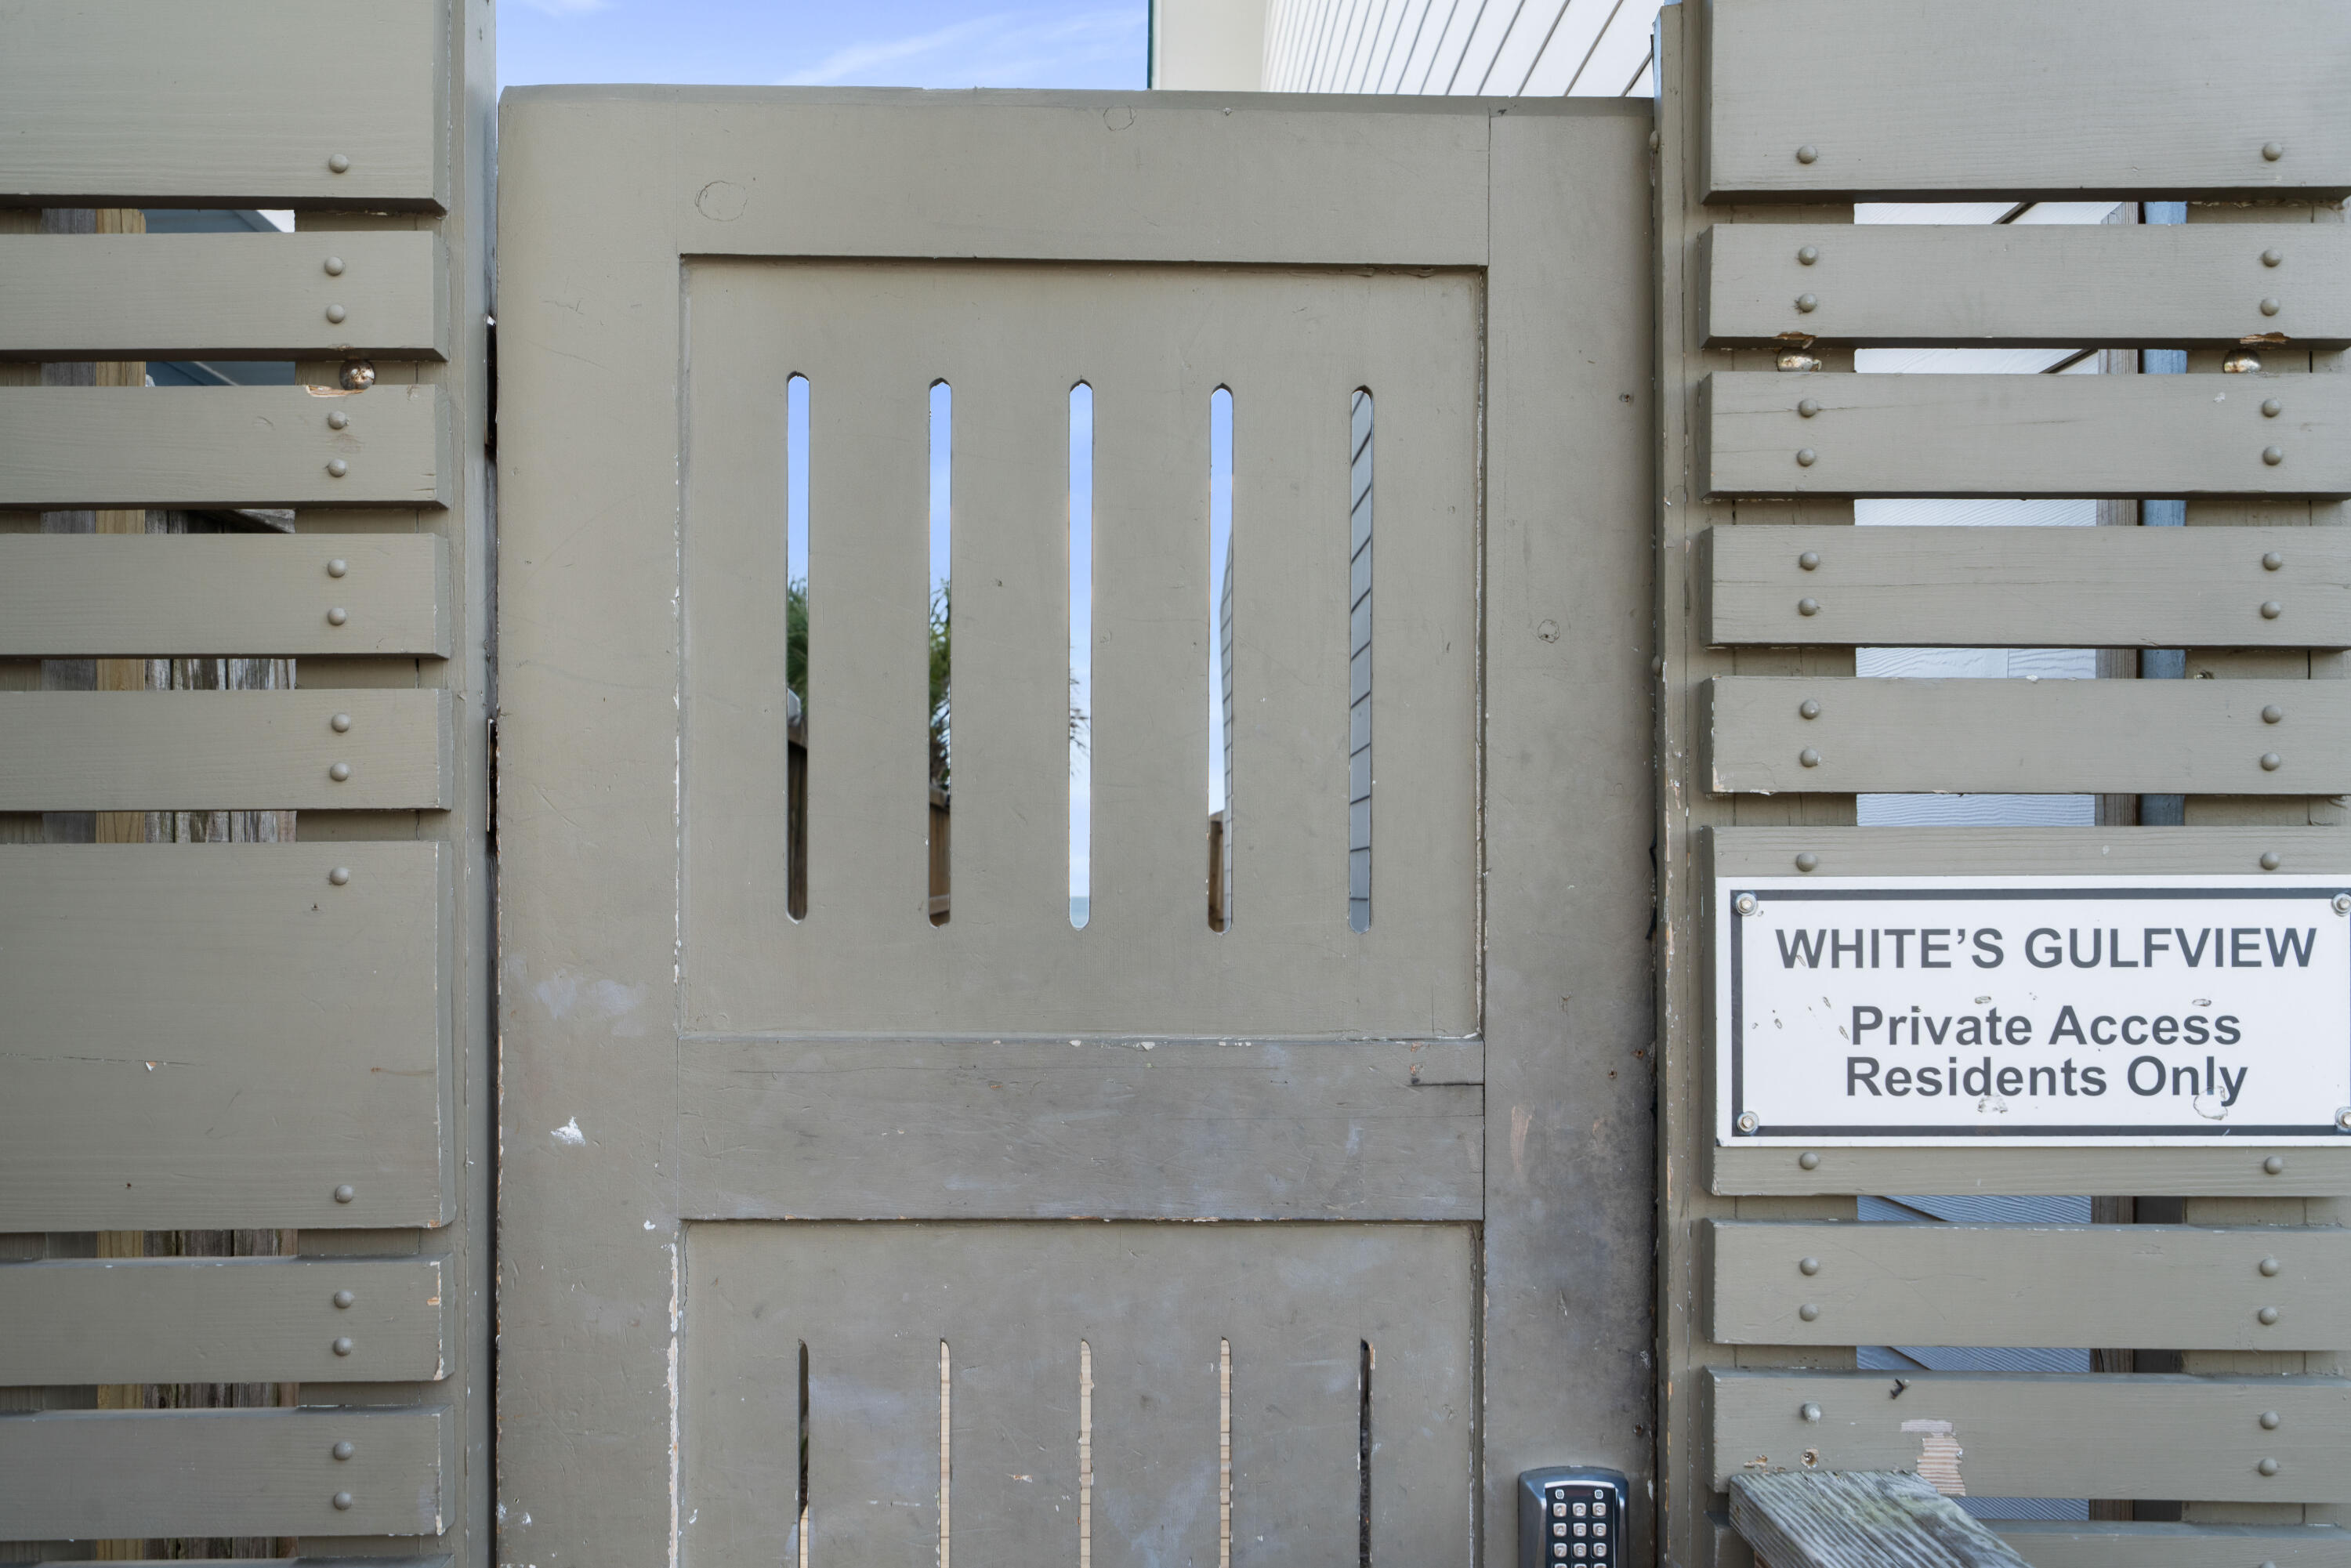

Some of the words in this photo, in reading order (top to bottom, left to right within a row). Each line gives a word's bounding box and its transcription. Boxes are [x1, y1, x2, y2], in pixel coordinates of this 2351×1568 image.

[1775, 928, 2005, 969] WHITE’S
[2024, 927, 2317, 969] GULFVIEW
[1852, 1005, 2033, 1047] Private
[2049, 1005, 2242, 1046] Access
[1847, 1056, 2108, 1097] Residents
[2127, 1056, 2248, 1107] Only
